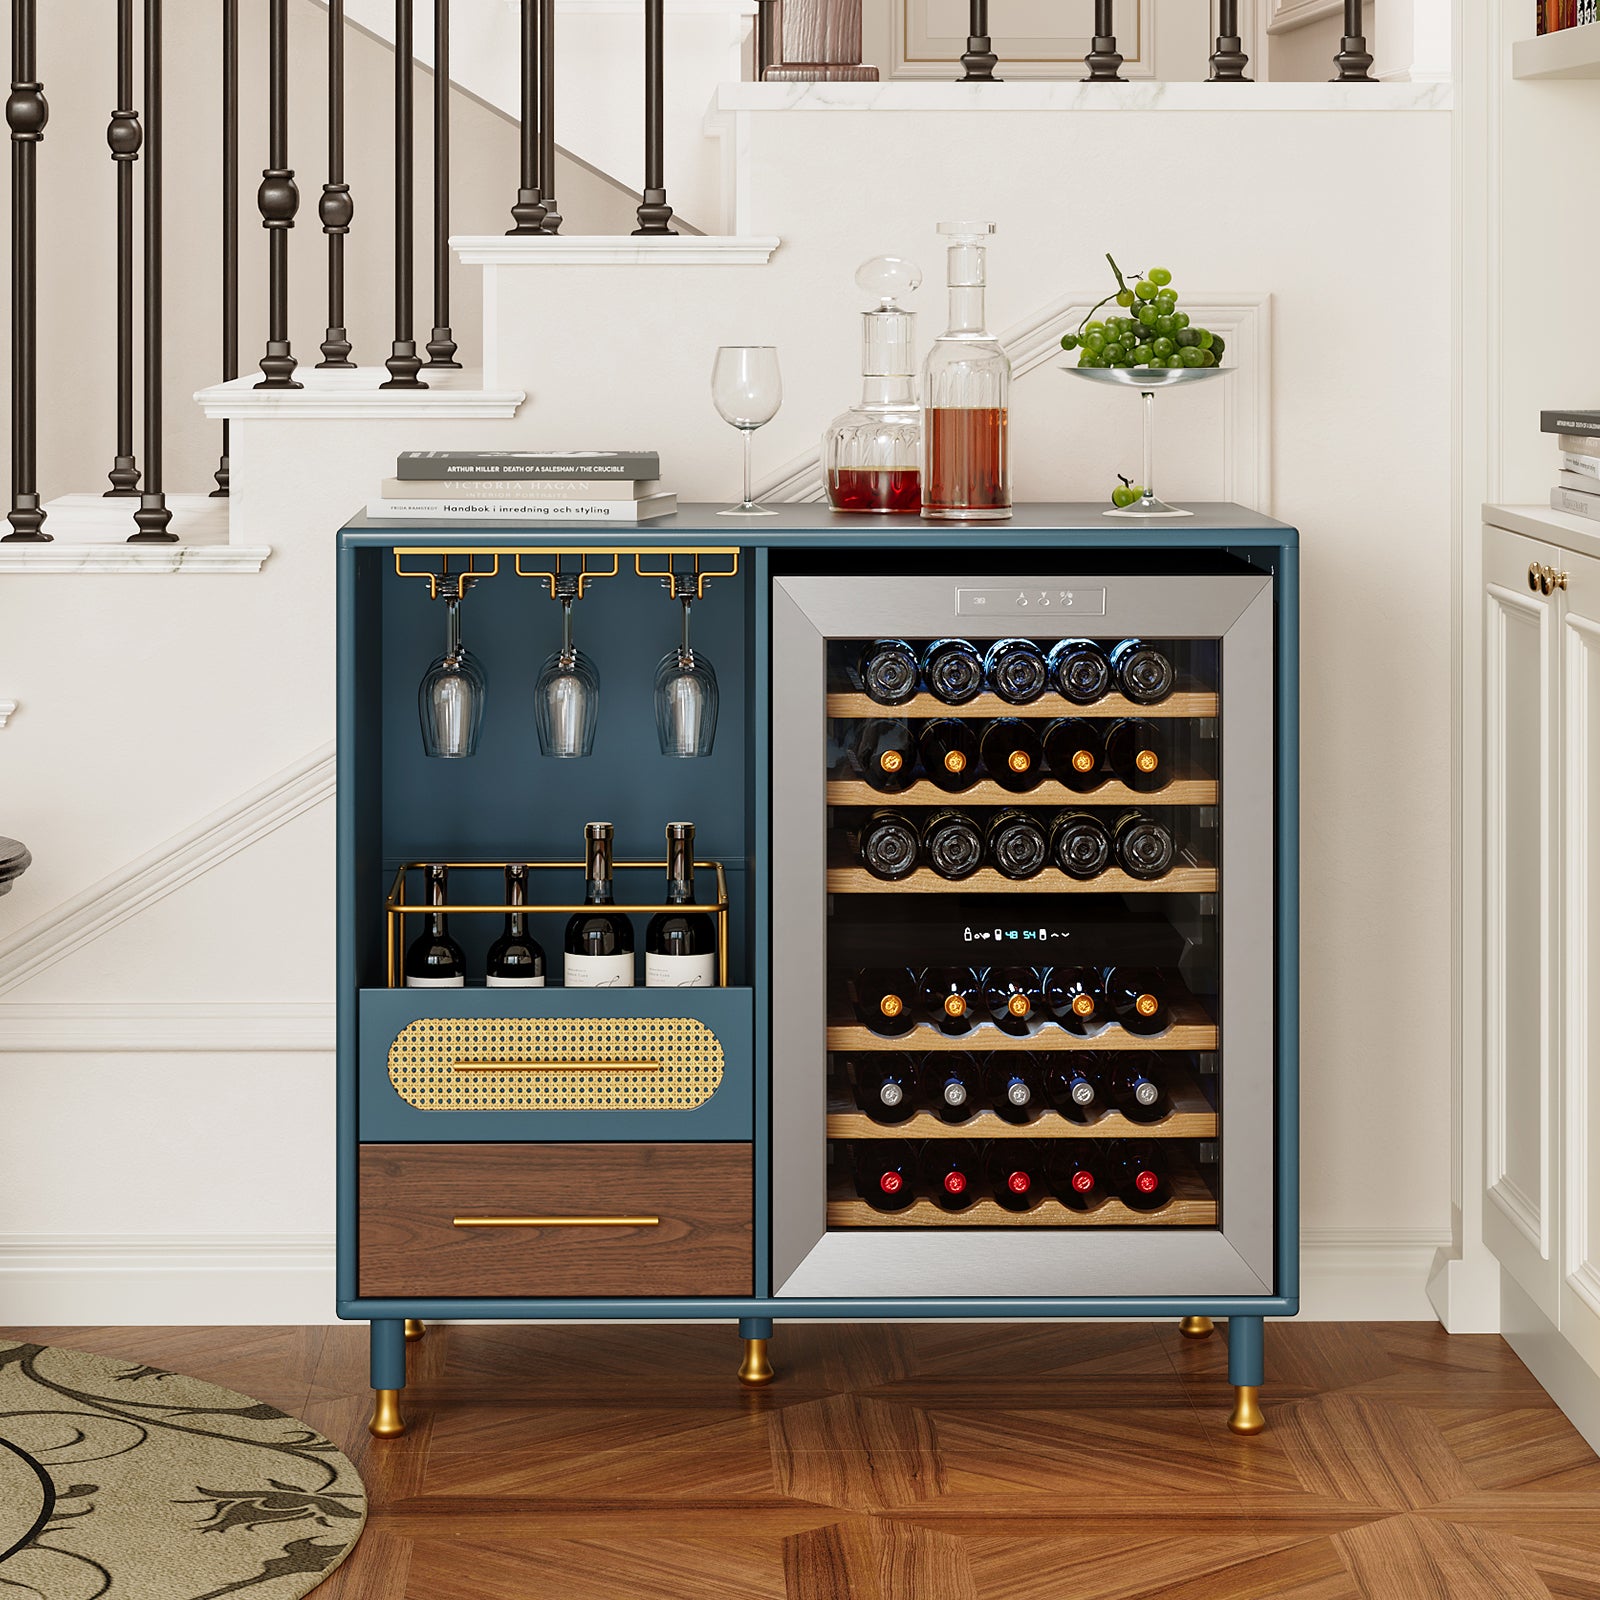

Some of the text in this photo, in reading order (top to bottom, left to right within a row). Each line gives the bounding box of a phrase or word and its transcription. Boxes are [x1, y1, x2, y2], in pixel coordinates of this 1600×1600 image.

[443, 482, 590, 490] VICTORIA HAGAN
[499, 505, 550, 514] inredning
[575, 506, 610, 515] styling
[1004, 930, 1037, 940] 48 54
